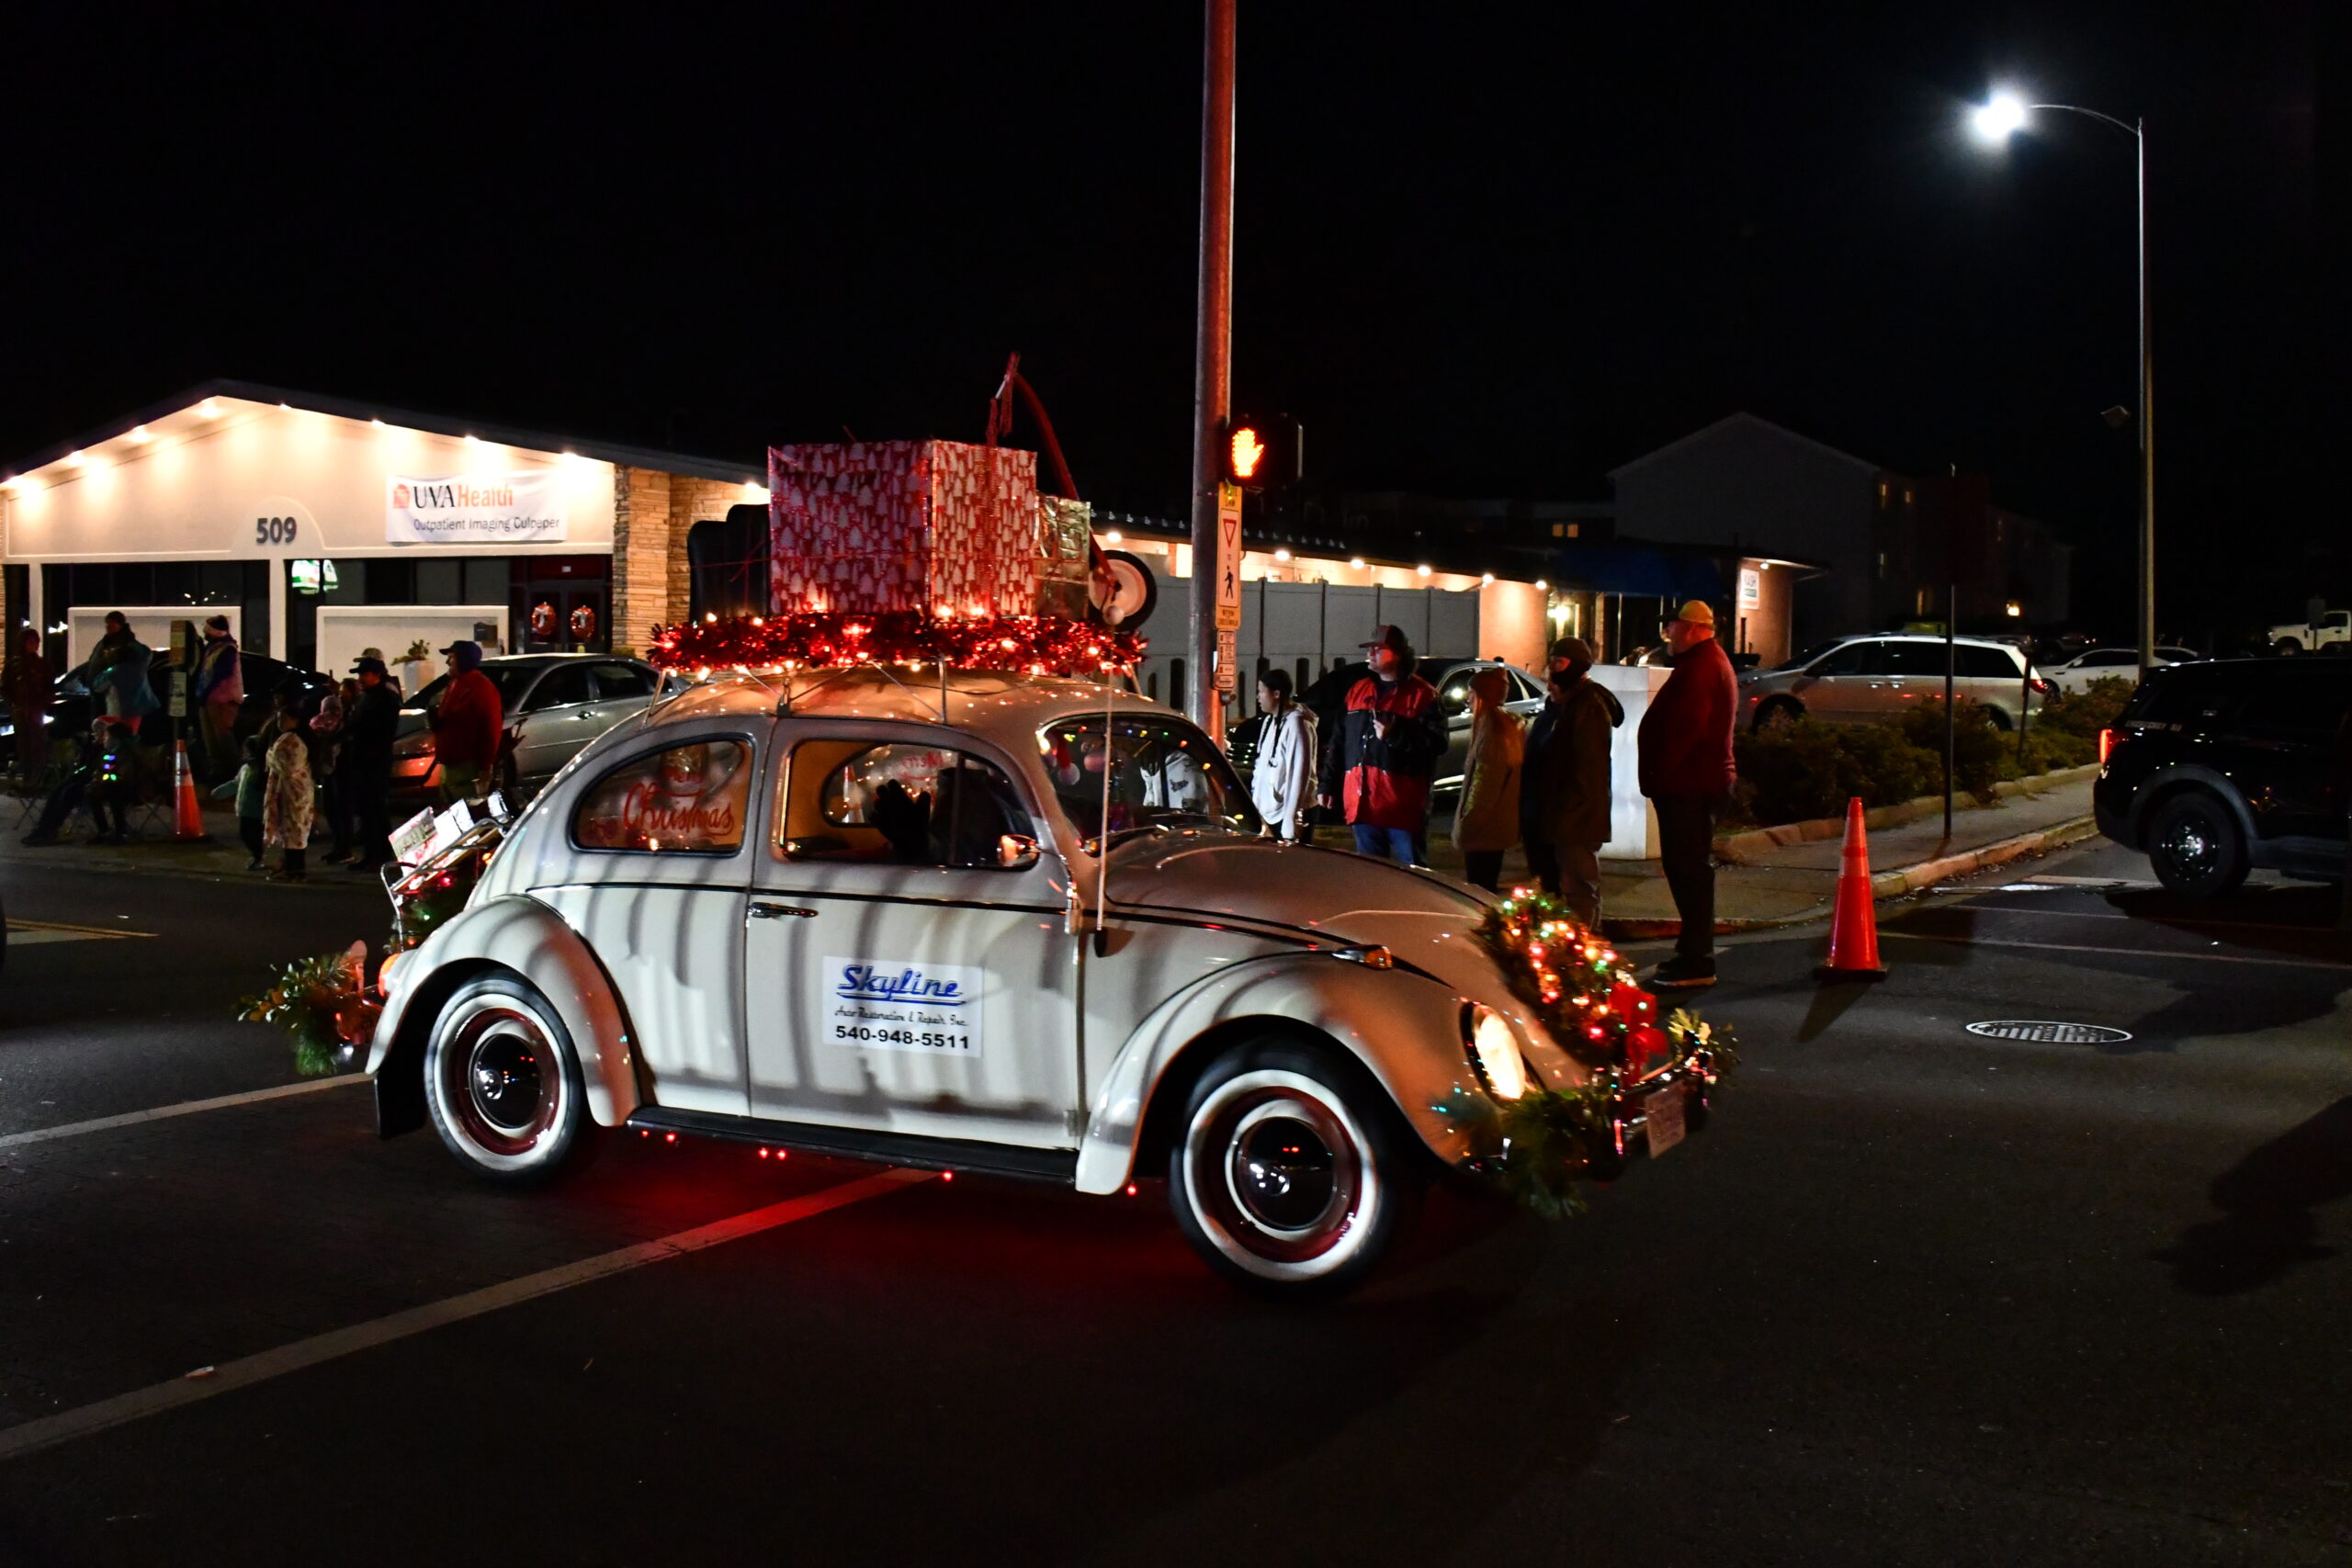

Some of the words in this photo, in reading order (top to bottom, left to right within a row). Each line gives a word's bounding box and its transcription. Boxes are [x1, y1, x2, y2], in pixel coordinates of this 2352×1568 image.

[413, 485, 456, 509] UVA
[458, 484, 514, 508] Health
[256, 516, 297, 544] 509
[413, 518, 466, 532] Outpatient
[469, 518, 510, 532] Imaging
[514, 516, 560, 530] Culpeper
[622, 782, 736, 836] Christmas
[837, 964, 964, 1000] Skyline
[836, 1025, 968, 1048] 540-948-5511
